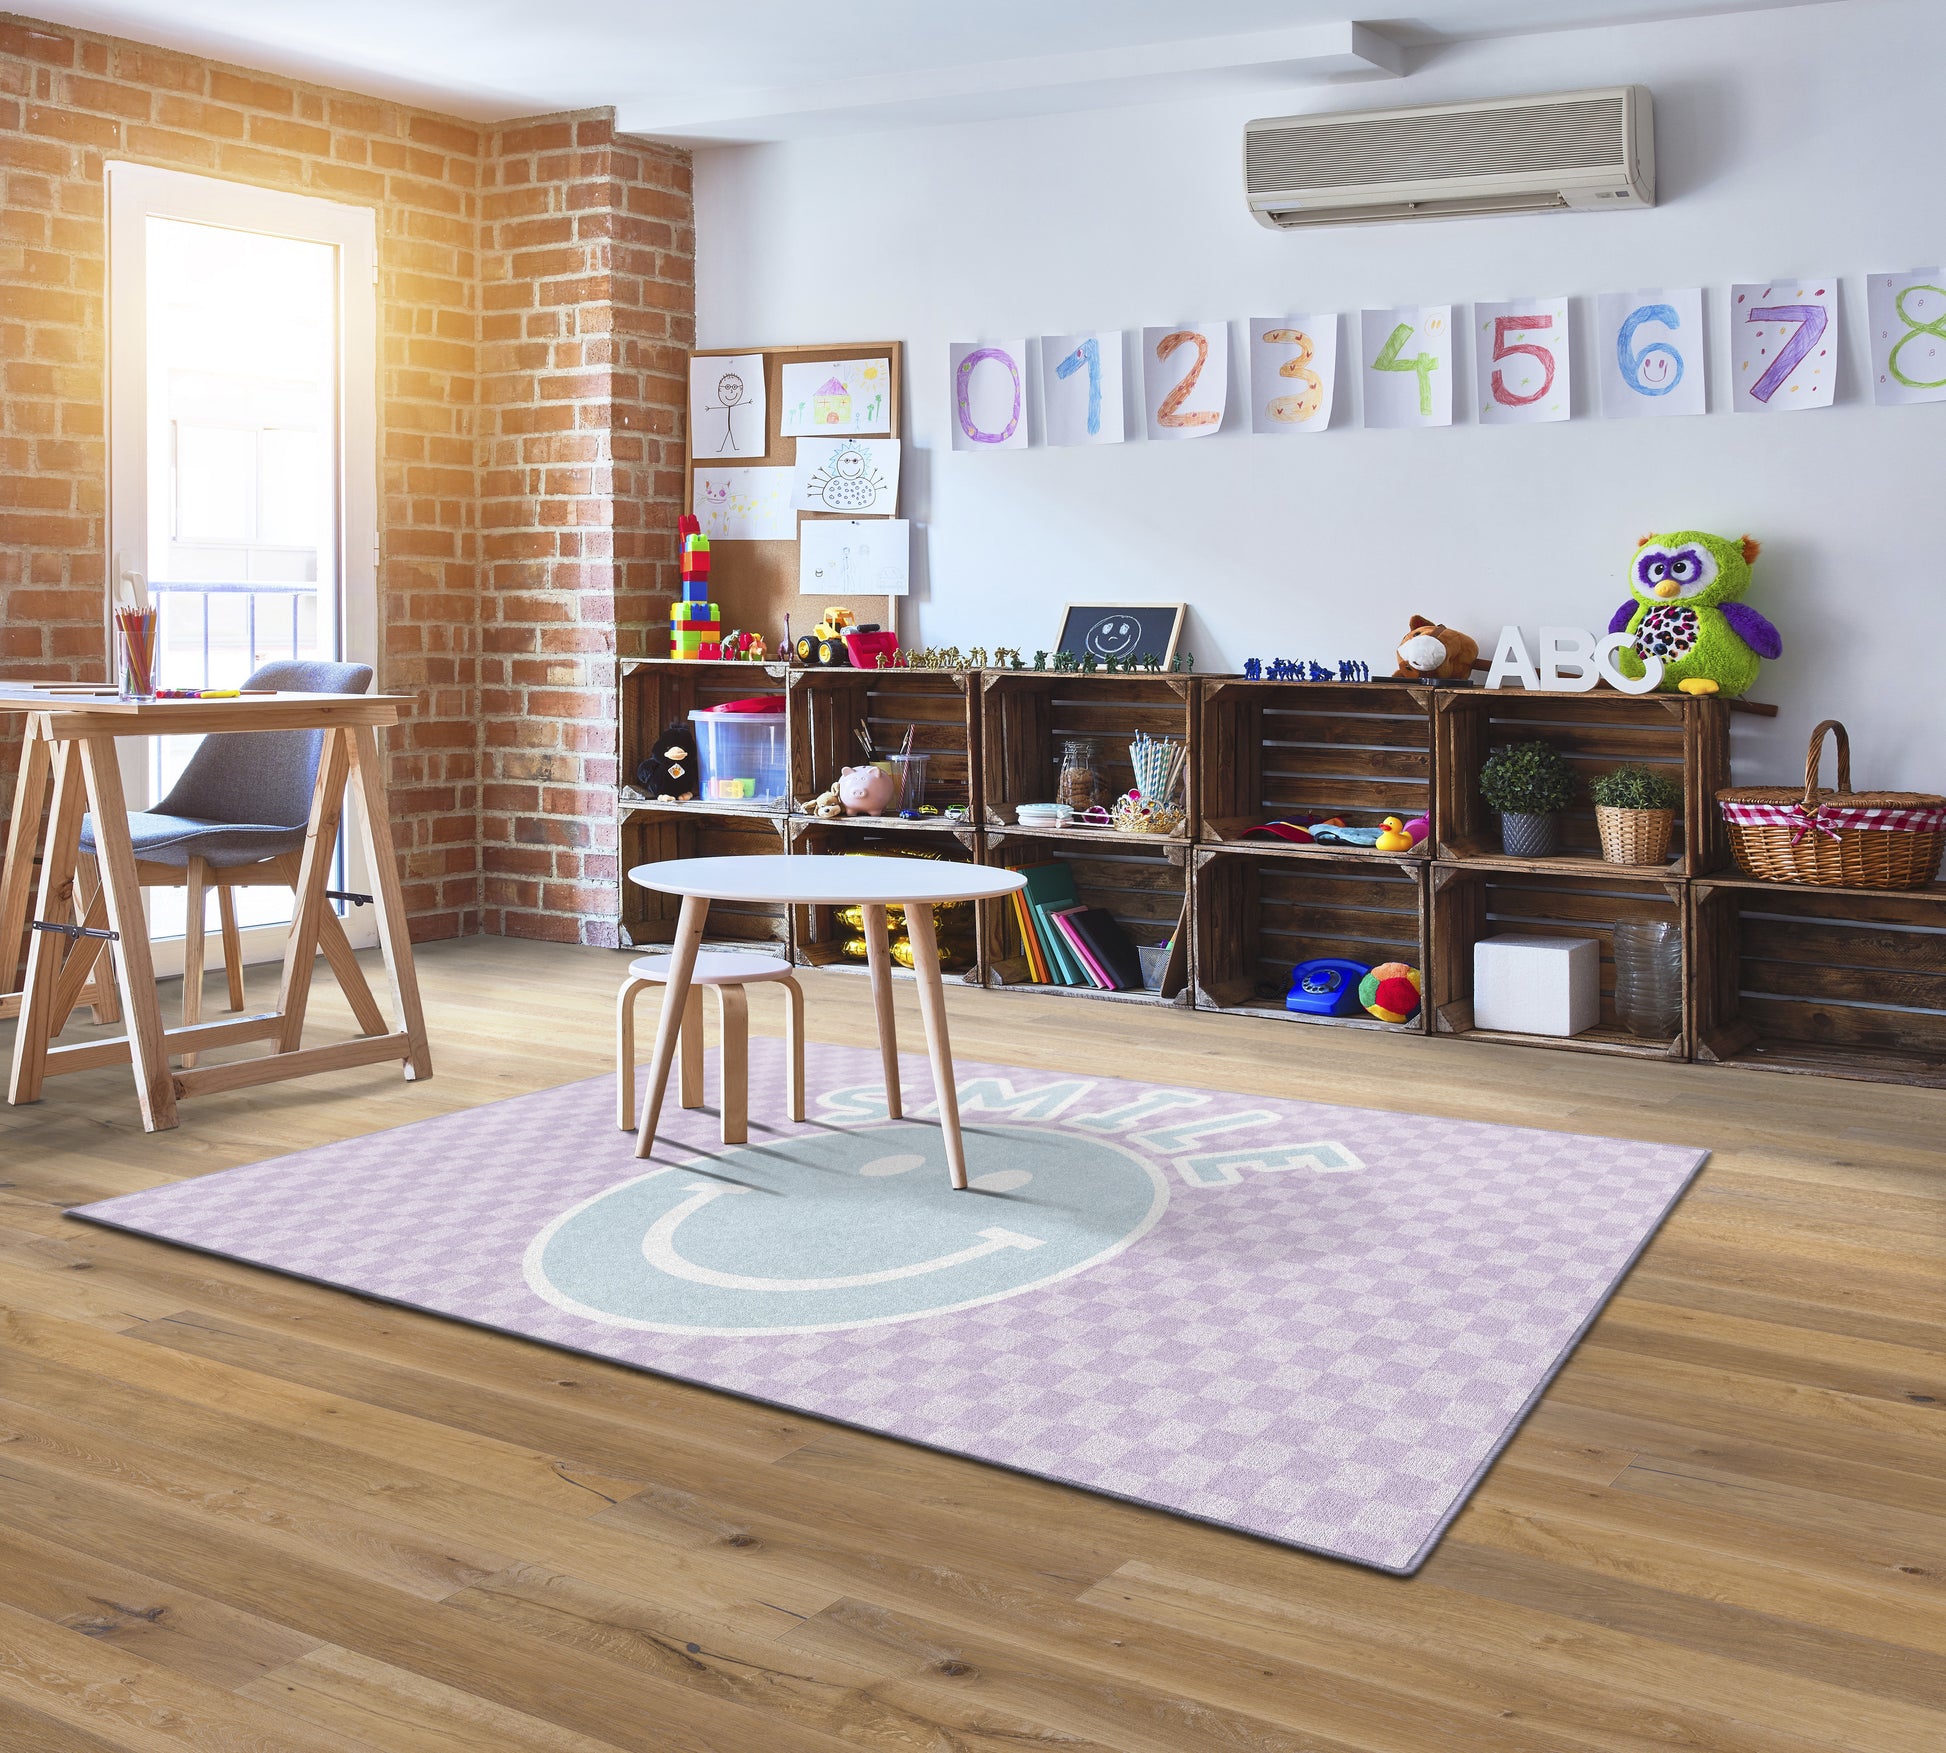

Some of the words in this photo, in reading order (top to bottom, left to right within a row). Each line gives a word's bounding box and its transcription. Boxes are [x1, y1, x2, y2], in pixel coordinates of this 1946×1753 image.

[957, 348, 1020, 443] 0
[1056, 338, 1103, 435] 1
[1157, 330, 1220, 428] 2
[1263, 329, 1324, 424] 3
[1371, 323, 1438, 416] 4
[1492, 315, 1555, 408] 5
[1617, 304, 1684, 397] 6
[1746, 305, 1828, 404] 7
[1888, 285, 1946, 388] 8
[1484, 626, 1665, 695] ABC
[816, 1077, 1364, 1187] SMILE
